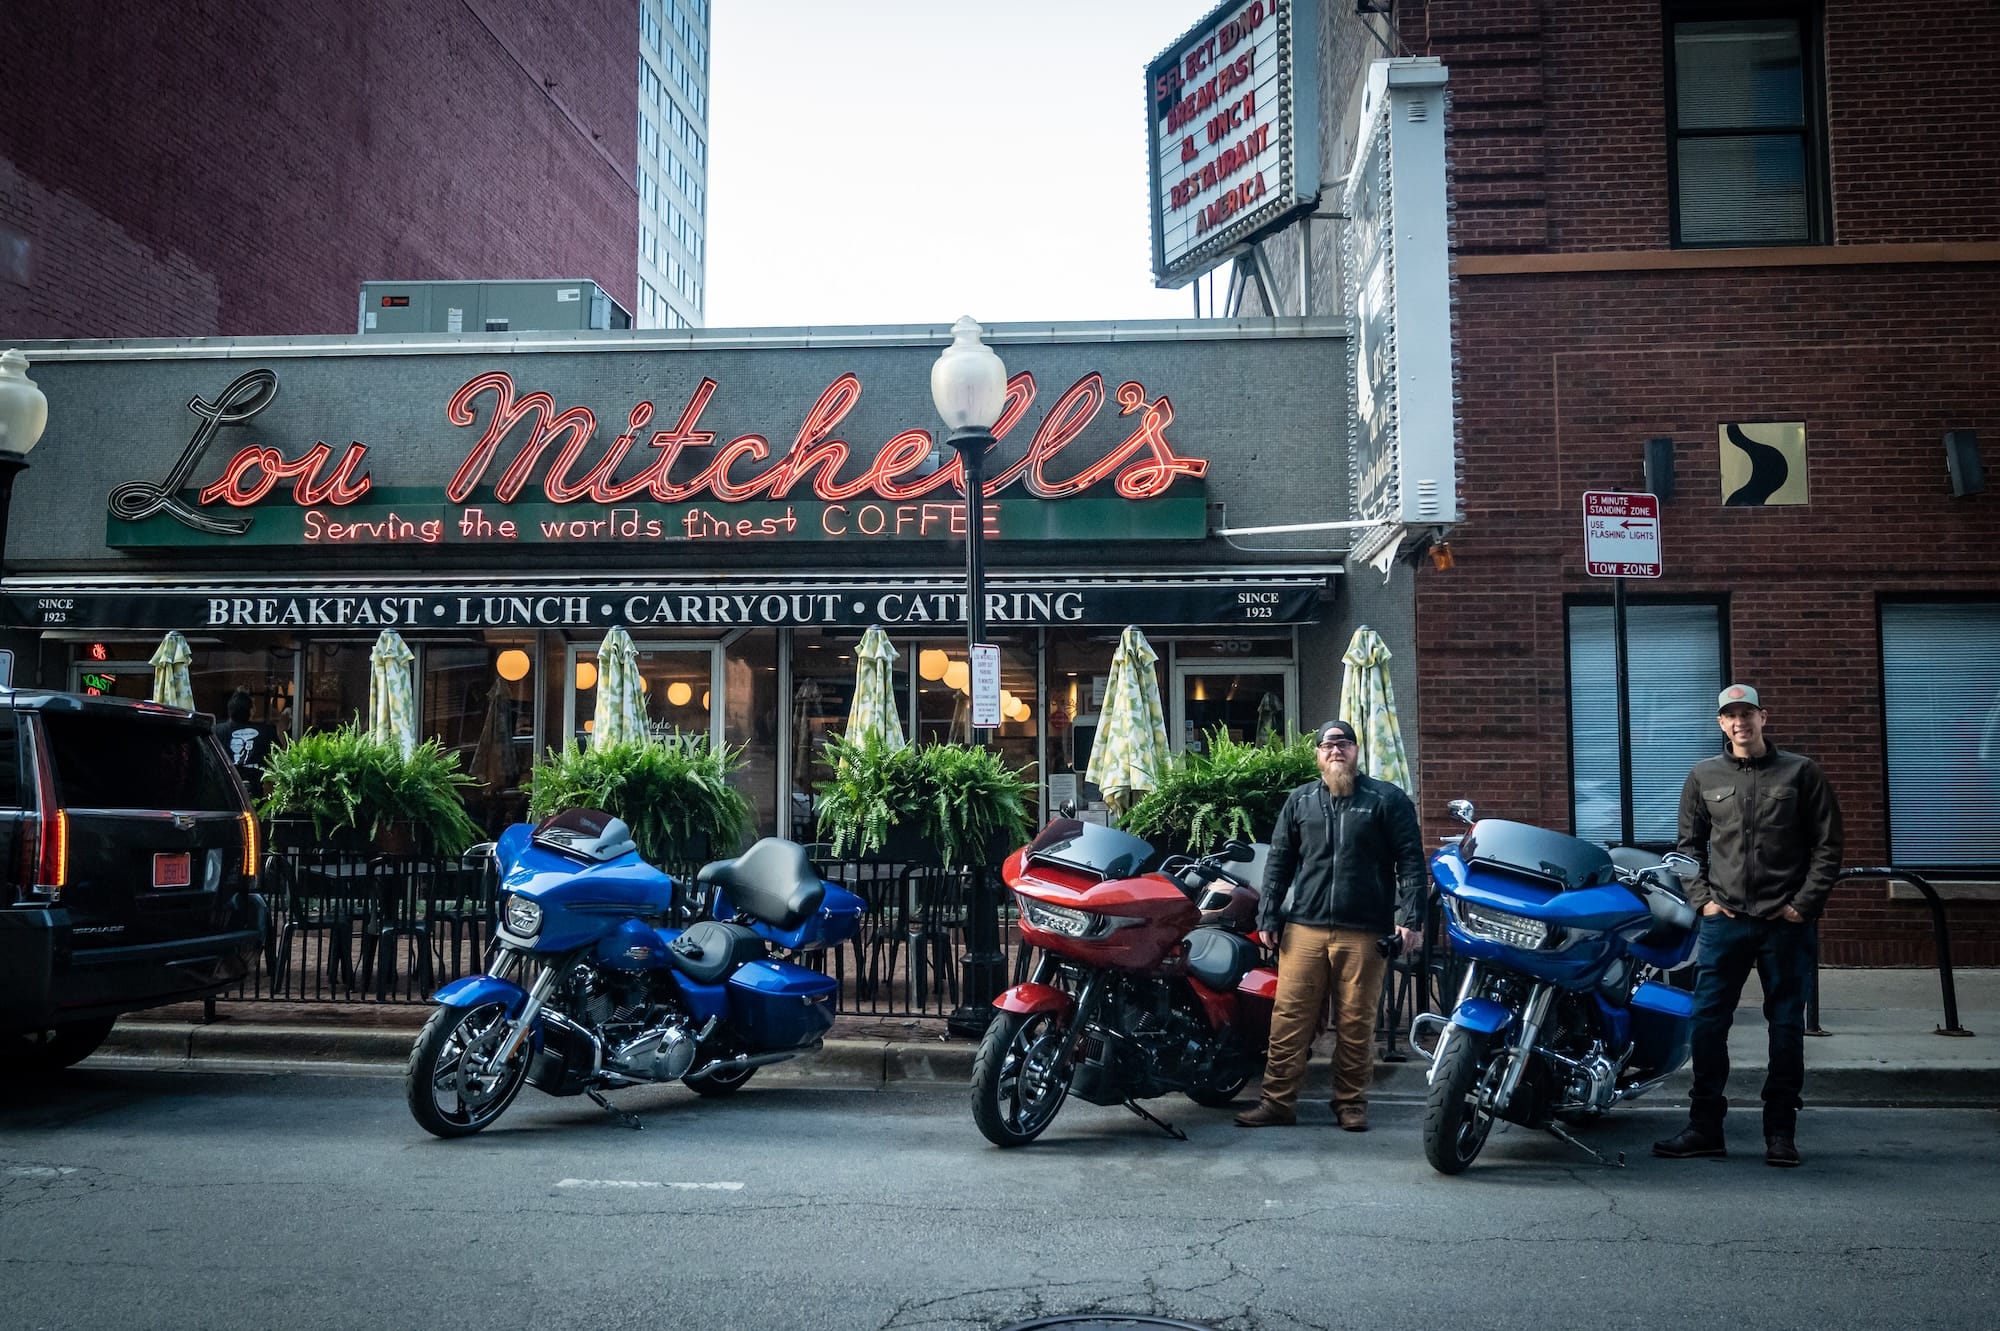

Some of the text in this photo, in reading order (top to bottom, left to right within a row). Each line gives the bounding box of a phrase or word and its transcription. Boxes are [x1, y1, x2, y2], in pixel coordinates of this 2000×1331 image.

[1167, 46, 1257, 135] BREAKFAST
[1170, 122, 1270, 212] RESTAURANT
[1195, 172, 1267, 237] AMERICA
[107, 367, 372, 535] Lou
[446, 370, 1209, 504] Mitchell's
[1589, 495, 1629, 506] 15 MINUTE
[1590, 506, 1651, 516] STANDING ZONE
[303, 503, 1001, 544] Serving the worlds finest COFFEE
[1590, 520, 1605, 529] USE
[1590, 530, 1654, 540] FLASHING LIGHTS
[1592, 563, 1655, 575] TOW ZONE
[37, 598, 74, 610] SINCE
[1237, 592, 1280, 604] SINCE
[207, 597, 425, 626] BREAKFAST
[456, 596, 589, 625] LUNCH
[624, 594, 842, 624] CARRYOUT
[1245, 607, 1273, 618] 1923
[44, 612, 66, 623] 1923
